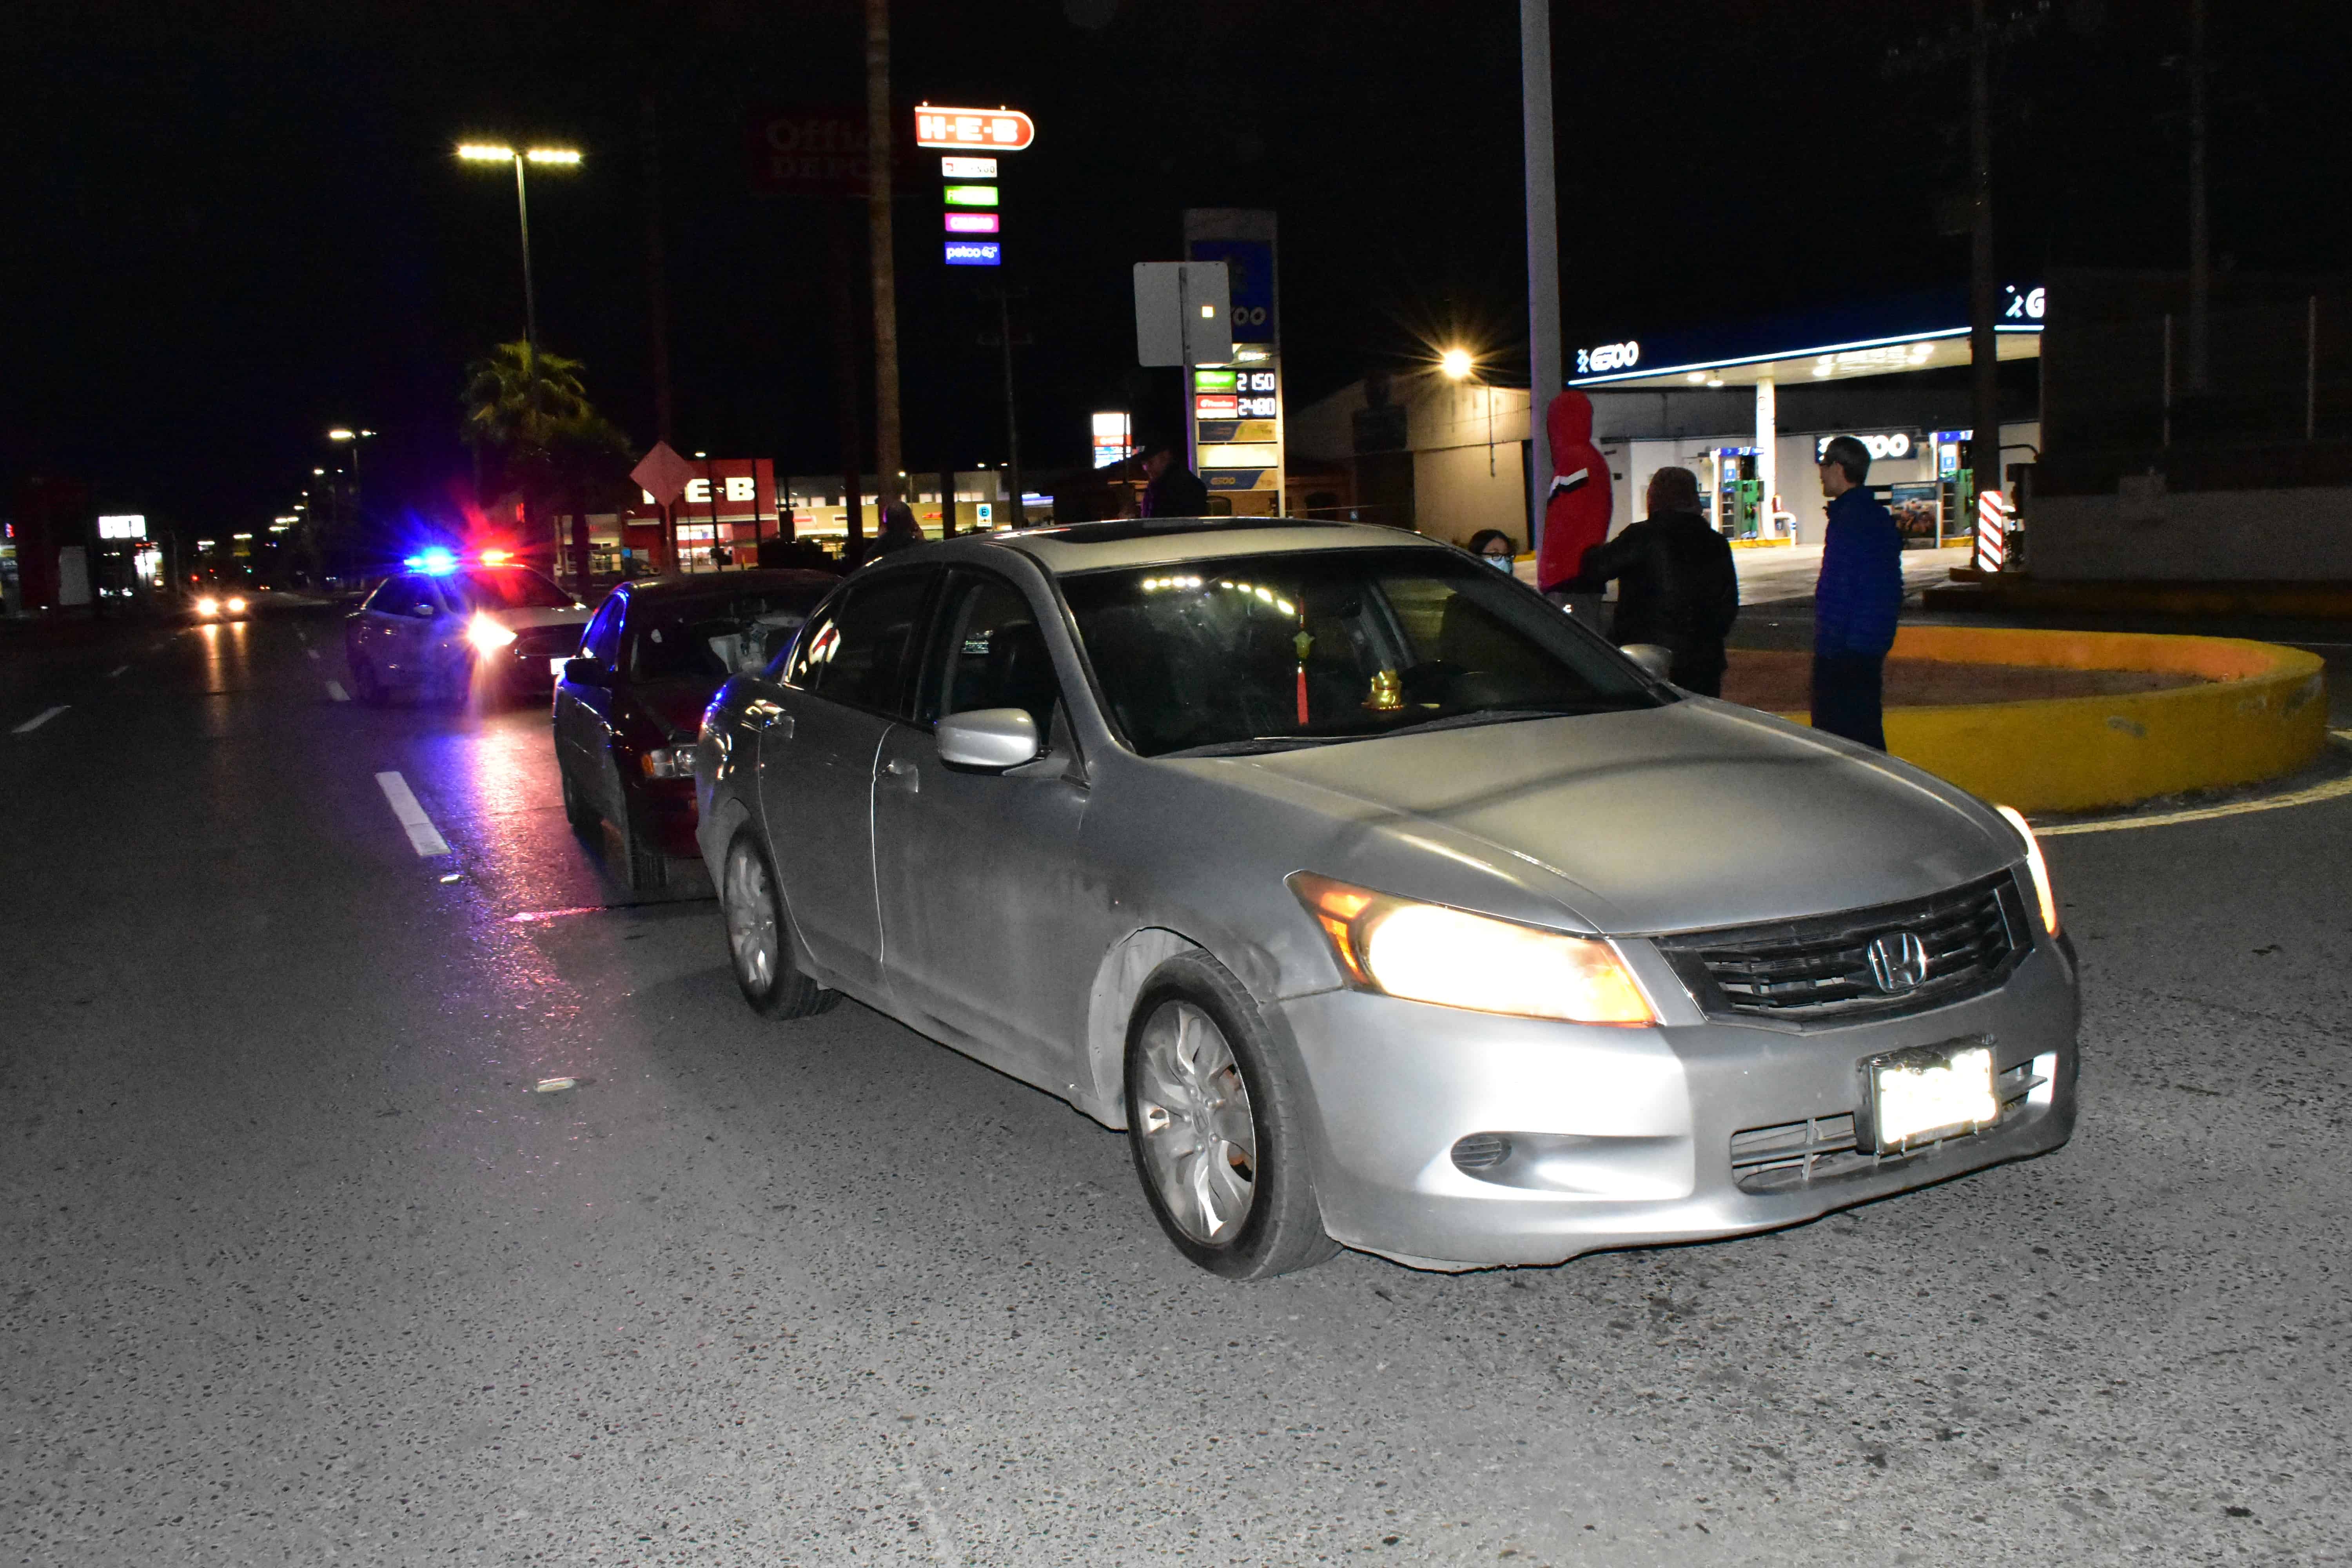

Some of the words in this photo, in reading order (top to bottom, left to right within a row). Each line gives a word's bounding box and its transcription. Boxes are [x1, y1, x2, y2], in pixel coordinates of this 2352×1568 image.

[919, 115, 1018, 142] H-E-B
[946, 246, 981, 259] petco
[1231, 305, 1267, 326] 00
[1590, 341, 1639, 371] G500
[981, 508, 987, 517] E
